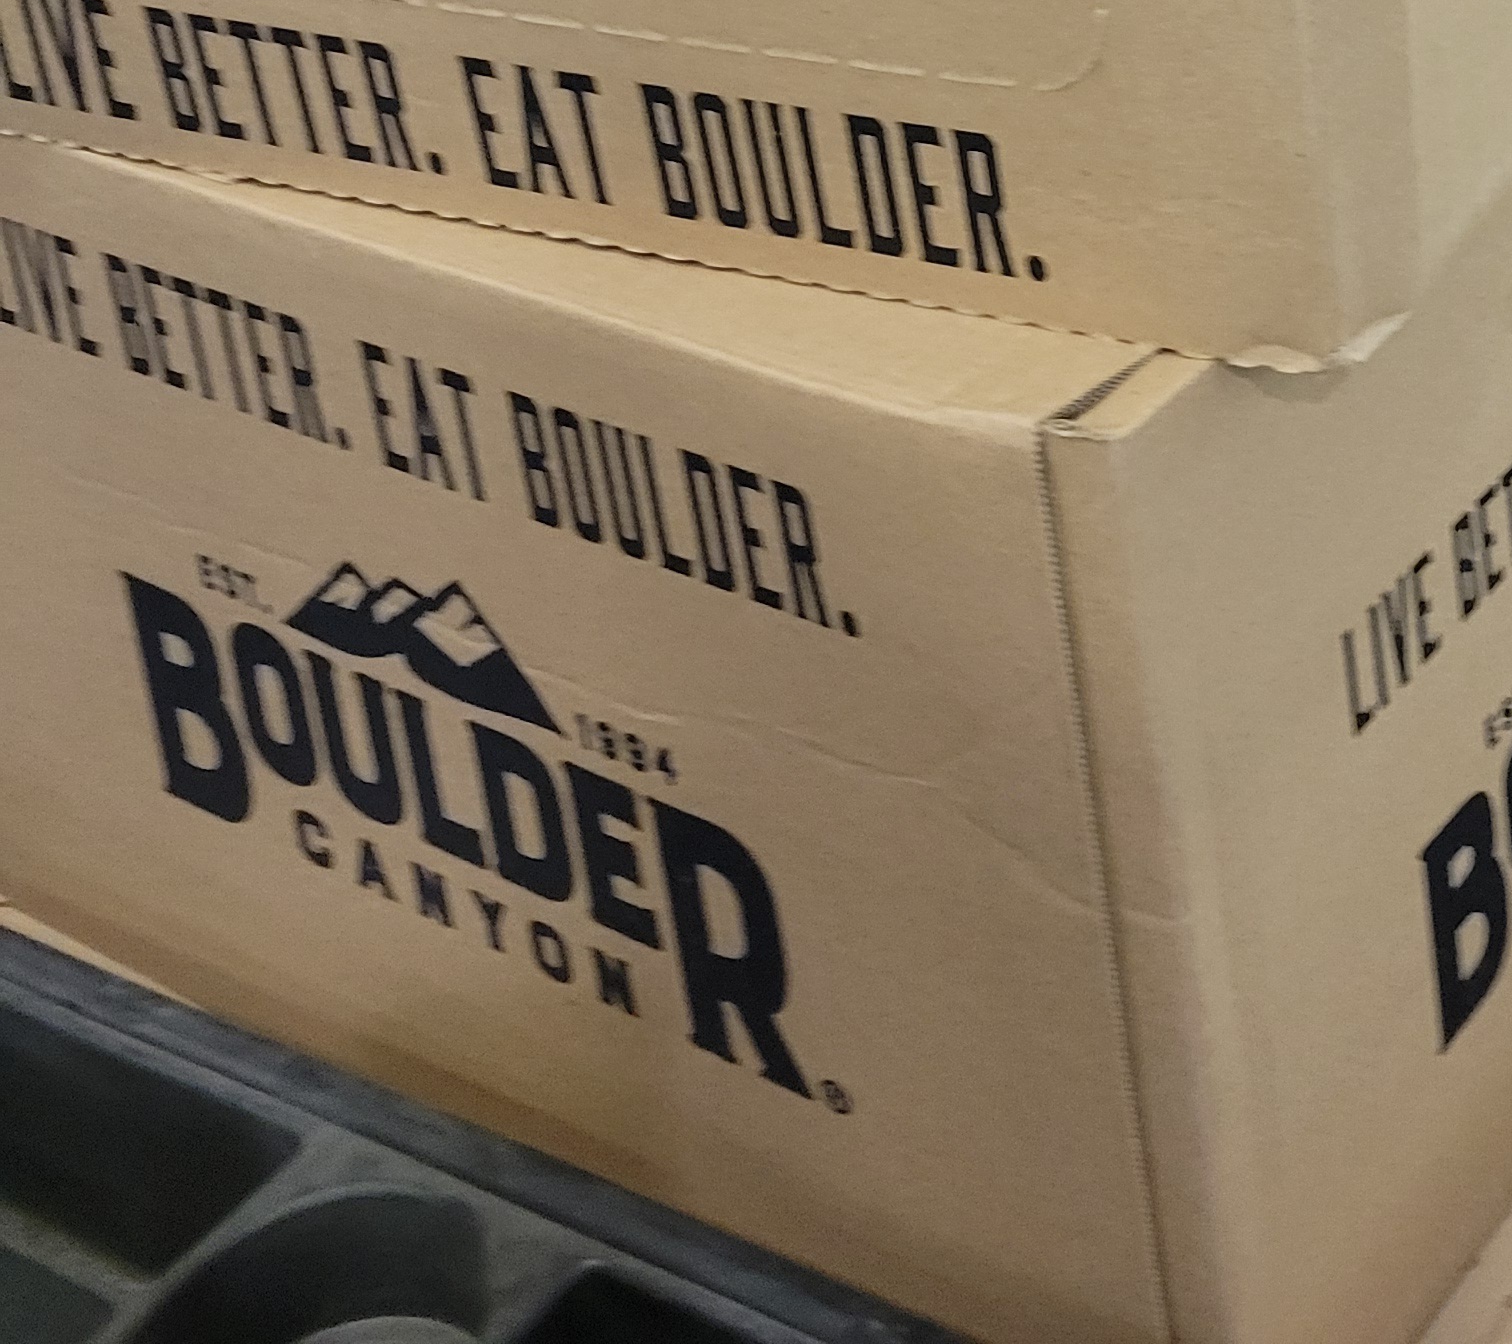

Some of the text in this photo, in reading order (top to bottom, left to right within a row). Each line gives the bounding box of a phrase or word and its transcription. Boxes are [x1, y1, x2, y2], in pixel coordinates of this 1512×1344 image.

[139, 5, 448, 176] BETTER.
[455, 55, 613, 205] EAT
[634, 81, 1052, 284] BOULDER.
[102, 250, 352, 451] BETTER.
[357, 338, 488, 503] EAT
[504, 387, 862, 637] BOULDER.
[1341, 550, 1443, 734] LIVE
[117, 567, 813, 1102] BOULDER
[295, 809, 641, 1018] CANYON
